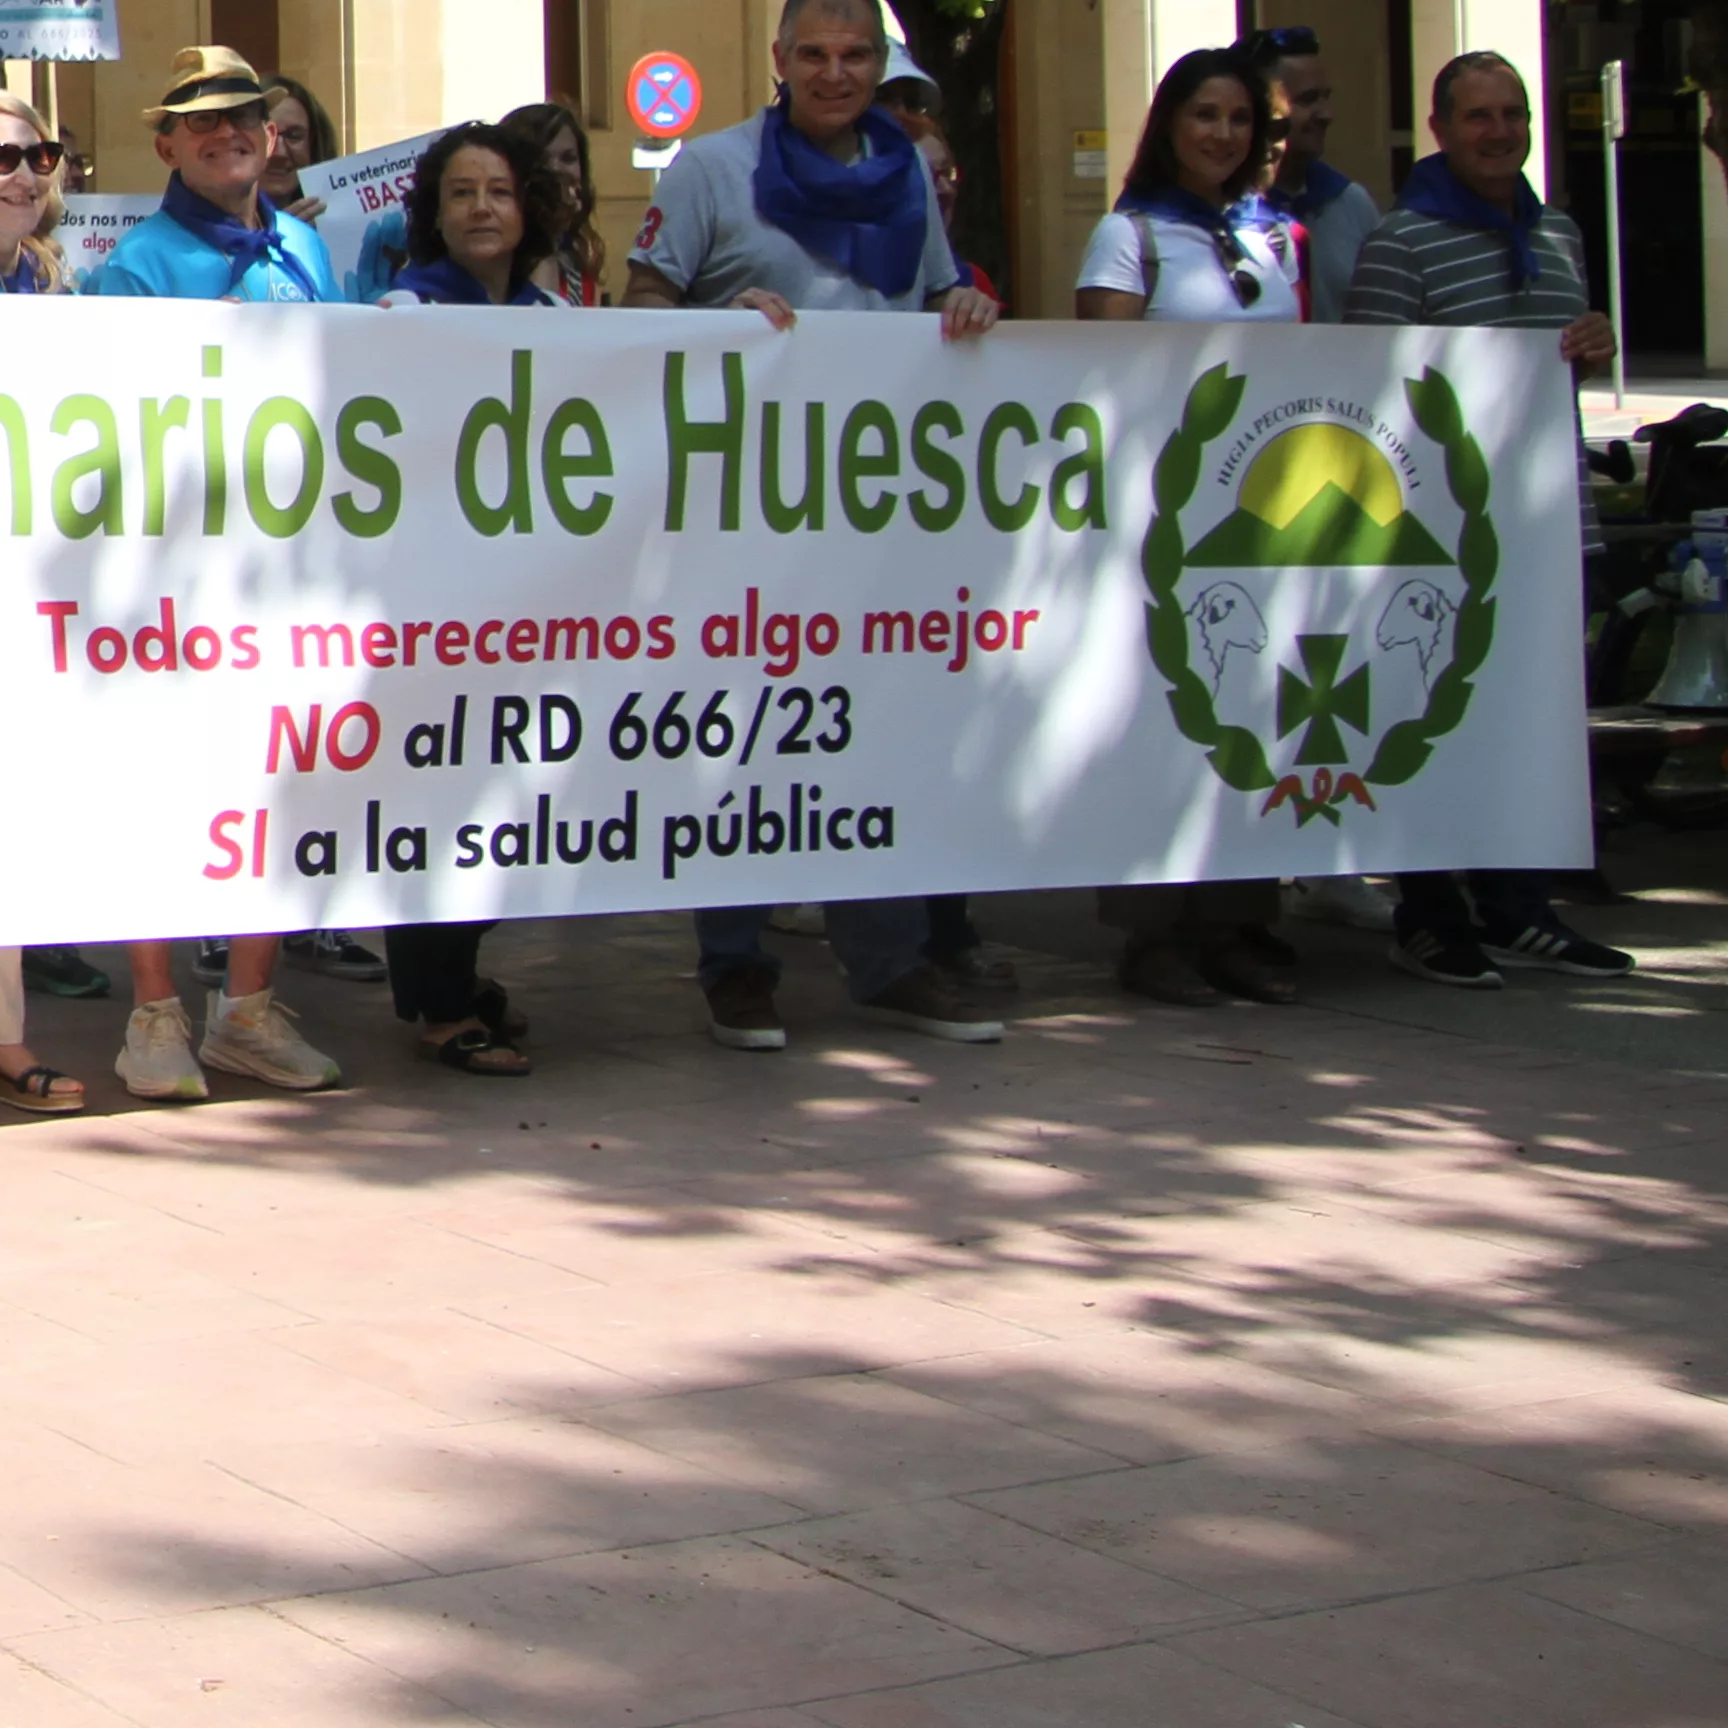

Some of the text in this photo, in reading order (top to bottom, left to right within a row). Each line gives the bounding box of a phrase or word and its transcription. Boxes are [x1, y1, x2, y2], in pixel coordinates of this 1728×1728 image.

[90, 215, 117, 227] nos
[328, 173, 348, 191] La
[82, 232, 116, 254] algo
[636, 206, 663, 250] 3
[454, 349, 615, 538] de
[662, 350, 1107, 534] Huesca
[1217, 396, 1421, 491] HIGIA PECORIS SALUS POPULI
[36, 586, 1042, 678] Todos merecemos algo mejor
[265, 685, 853, 774] NO al RD 666/23
[201, 783, 895, 881] SI a la salud pública
